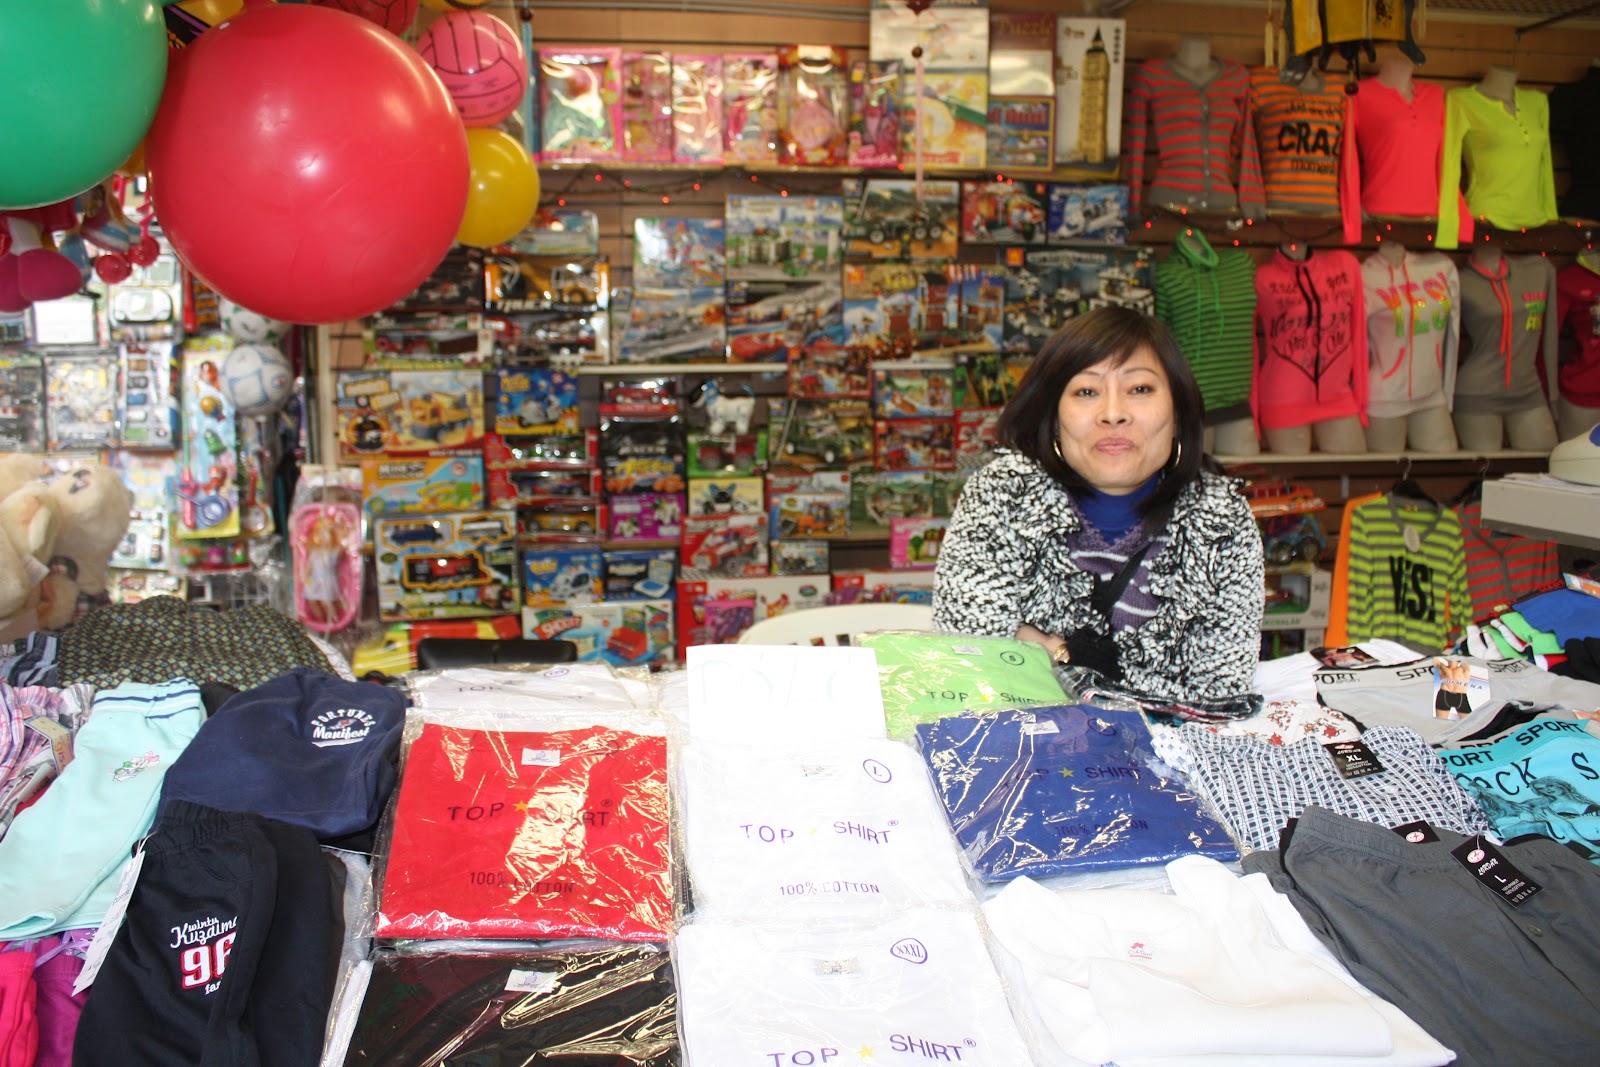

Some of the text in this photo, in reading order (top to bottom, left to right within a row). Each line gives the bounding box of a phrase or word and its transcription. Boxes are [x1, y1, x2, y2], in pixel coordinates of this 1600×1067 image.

[1515, 721, 1584, 746] SPORT
[1346, 754, 1362, 762] XL
[448, 803, 504, 821] TOP
[740, 824, 794, 843] TOP
[1494, 875, 1506, 883] L
[780, 880, 880, 896] 100% COTTON
[896, 943, 924, 958] XXXL
[767, 1047, 839, 1067] TOP
